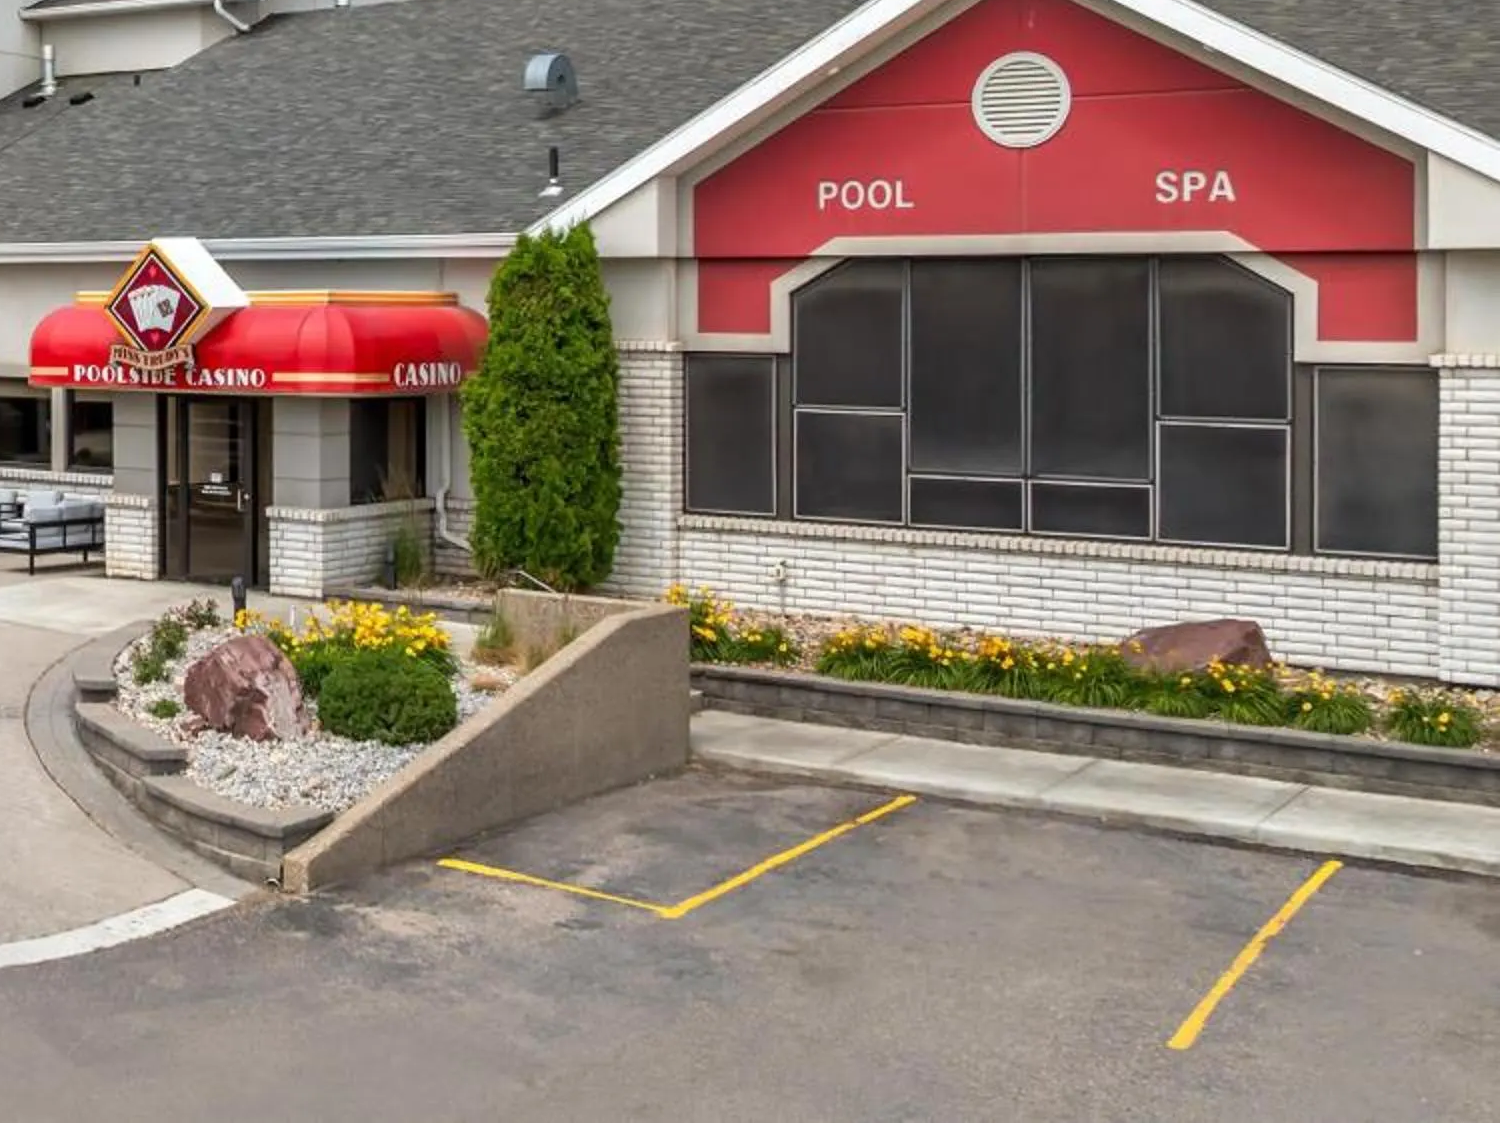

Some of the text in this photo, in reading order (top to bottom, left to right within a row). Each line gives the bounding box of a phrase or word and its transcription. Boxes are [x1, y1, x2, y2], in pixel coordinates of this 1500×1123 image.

[818, 179, 916, 211] POOL
[1155, 170, 1237, 204] SPA
[73, 363, 266, 387] POOLSIDE CASINO
[393, 362, 461, 387] CASINO
